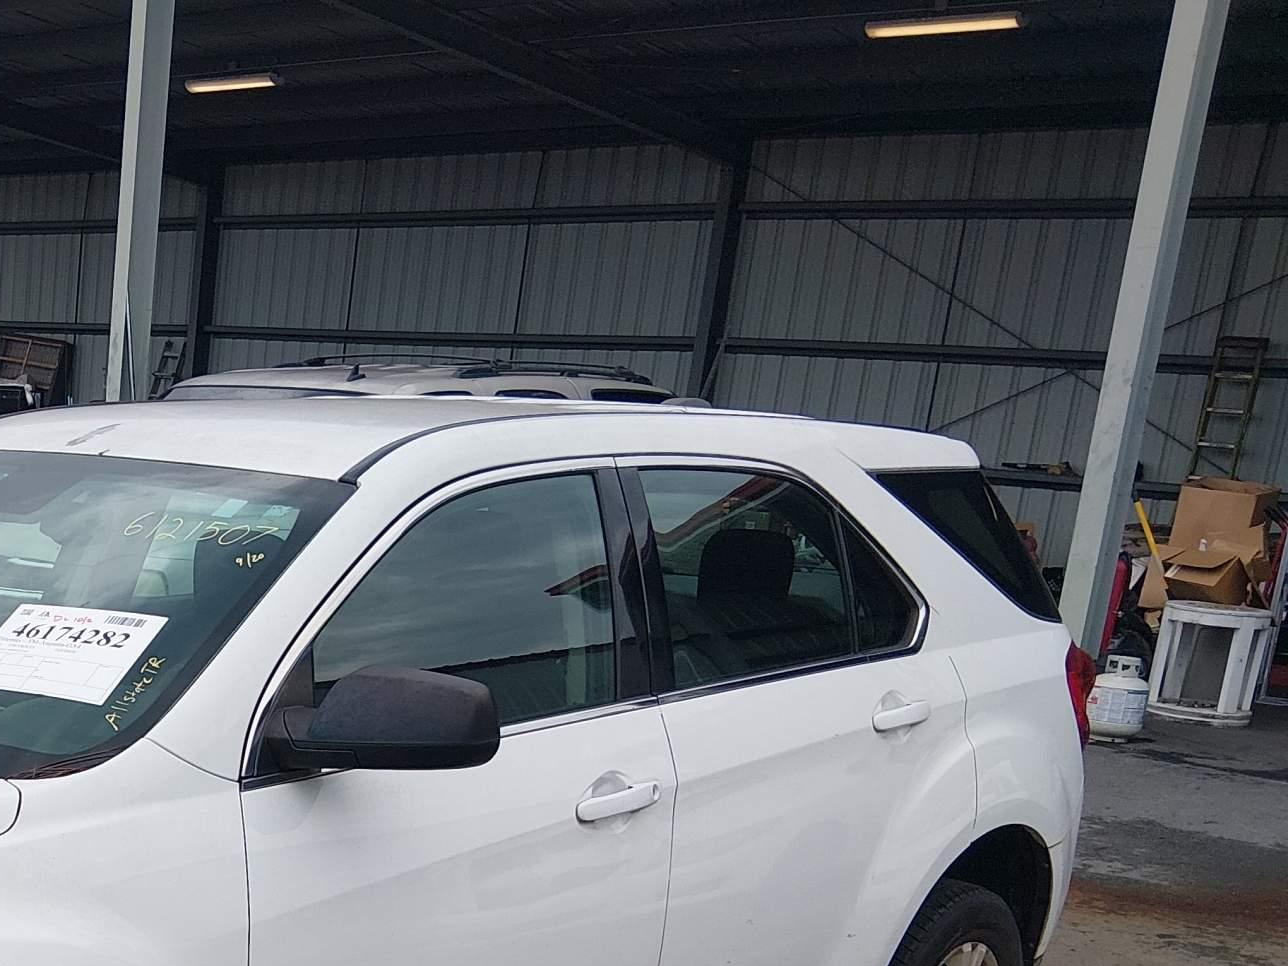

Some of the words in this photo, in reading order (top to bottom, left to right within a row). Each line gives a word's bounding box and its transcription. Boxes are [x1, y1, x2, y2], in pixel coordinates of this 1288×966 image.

[123, 511, 279, 546] 6121507
[235, 552, 265, 568] 9/20
[11, 622, 131, 649] 46174282
